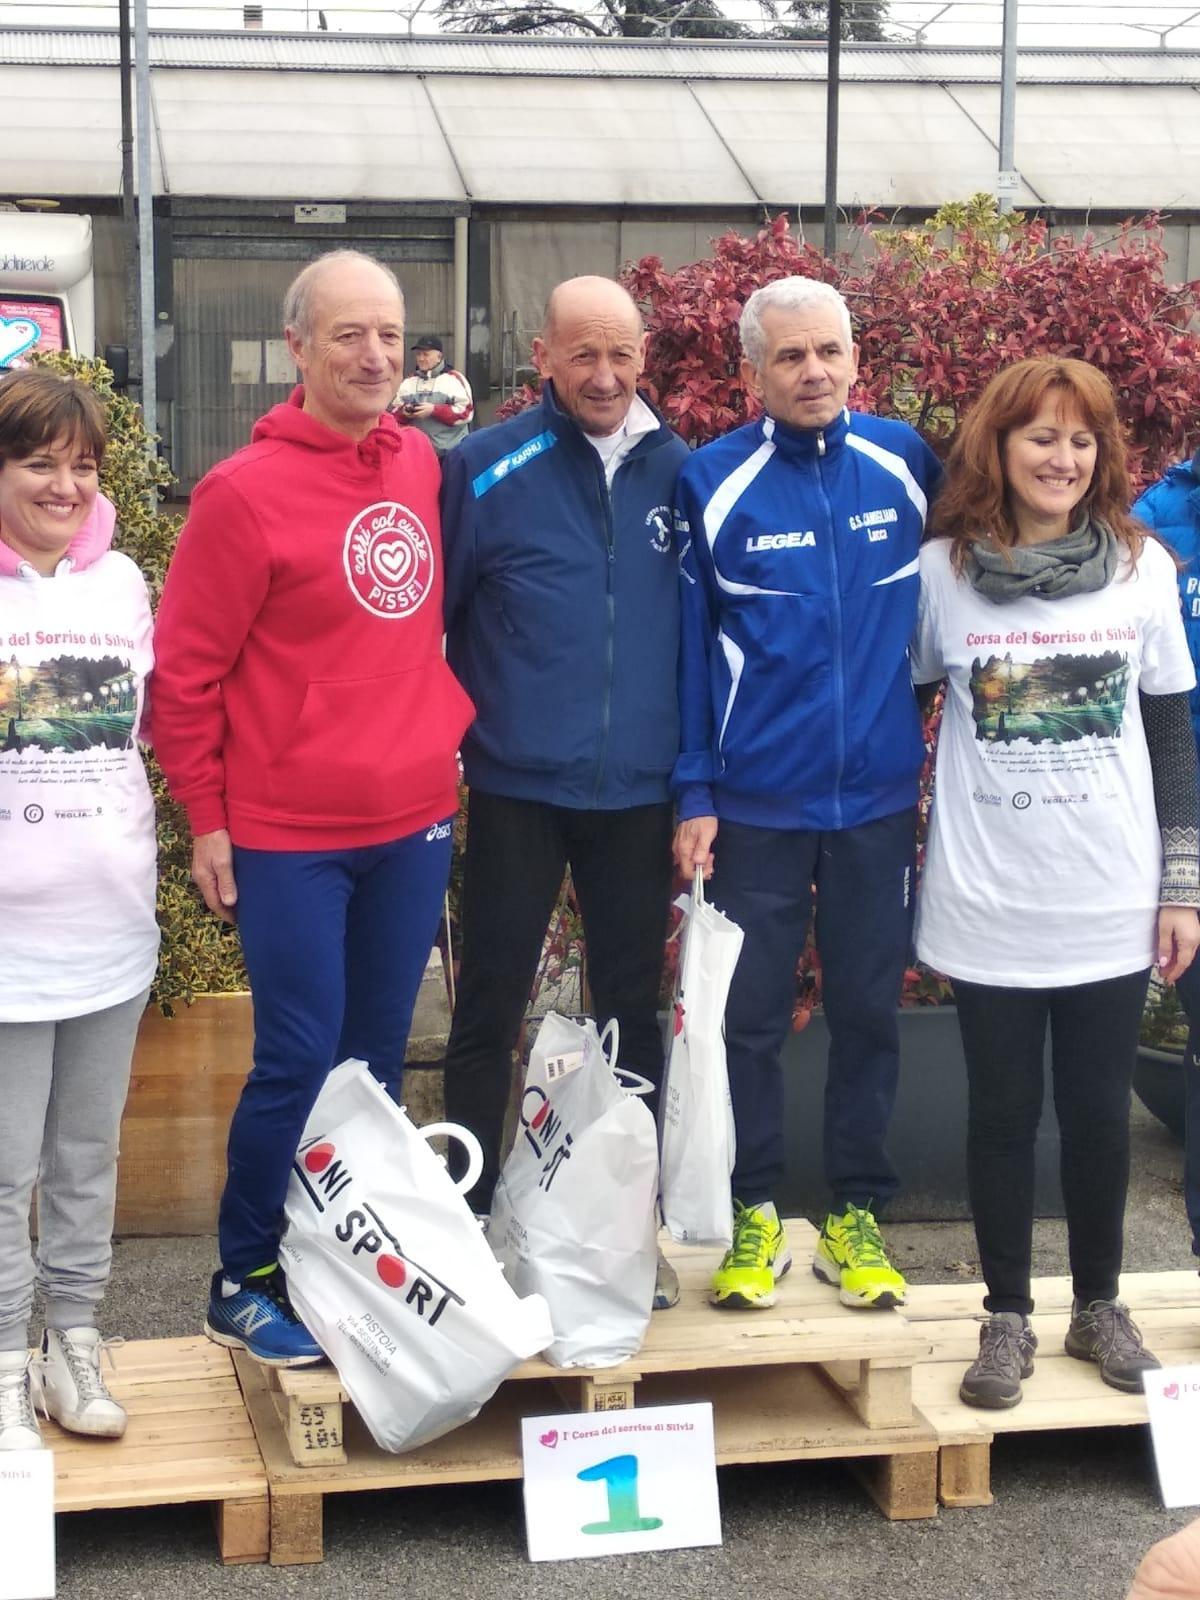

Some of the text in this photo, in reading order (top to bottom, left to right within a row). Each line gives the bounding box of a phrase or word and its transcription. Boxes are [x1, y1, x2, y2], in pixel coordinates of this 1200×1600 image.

[511, 441, 542, 466] KARHU
[371, 505, 397, 530] col
[397, 518, 429, 562] cuore
[746, 531, 817, 552] LEGEA
[368, 579, 424, 610] PISSEI
[8, 632, 30, 647] del
[35, 630, 86, 645] Sorriso
[90, 633, 101, 646] di
[105, 634, 135, 650] Silvia
[966, 626, 1137, 646] Corsa del Sorriso di Silvia
[335, 1202, 466, 1327] SPORT
[360, 1313, 397, 1356] PISTOIA
[571, 1430, 600, 1441] Corsa
[601, 1426, 617, 1436] del
[618, 1423, 652, 1433] sorriso
[654, 1423, 664, 1432] di
[666, 1422, 695, 1432] Silvia
[576, 1454, 664, 1535] 1
